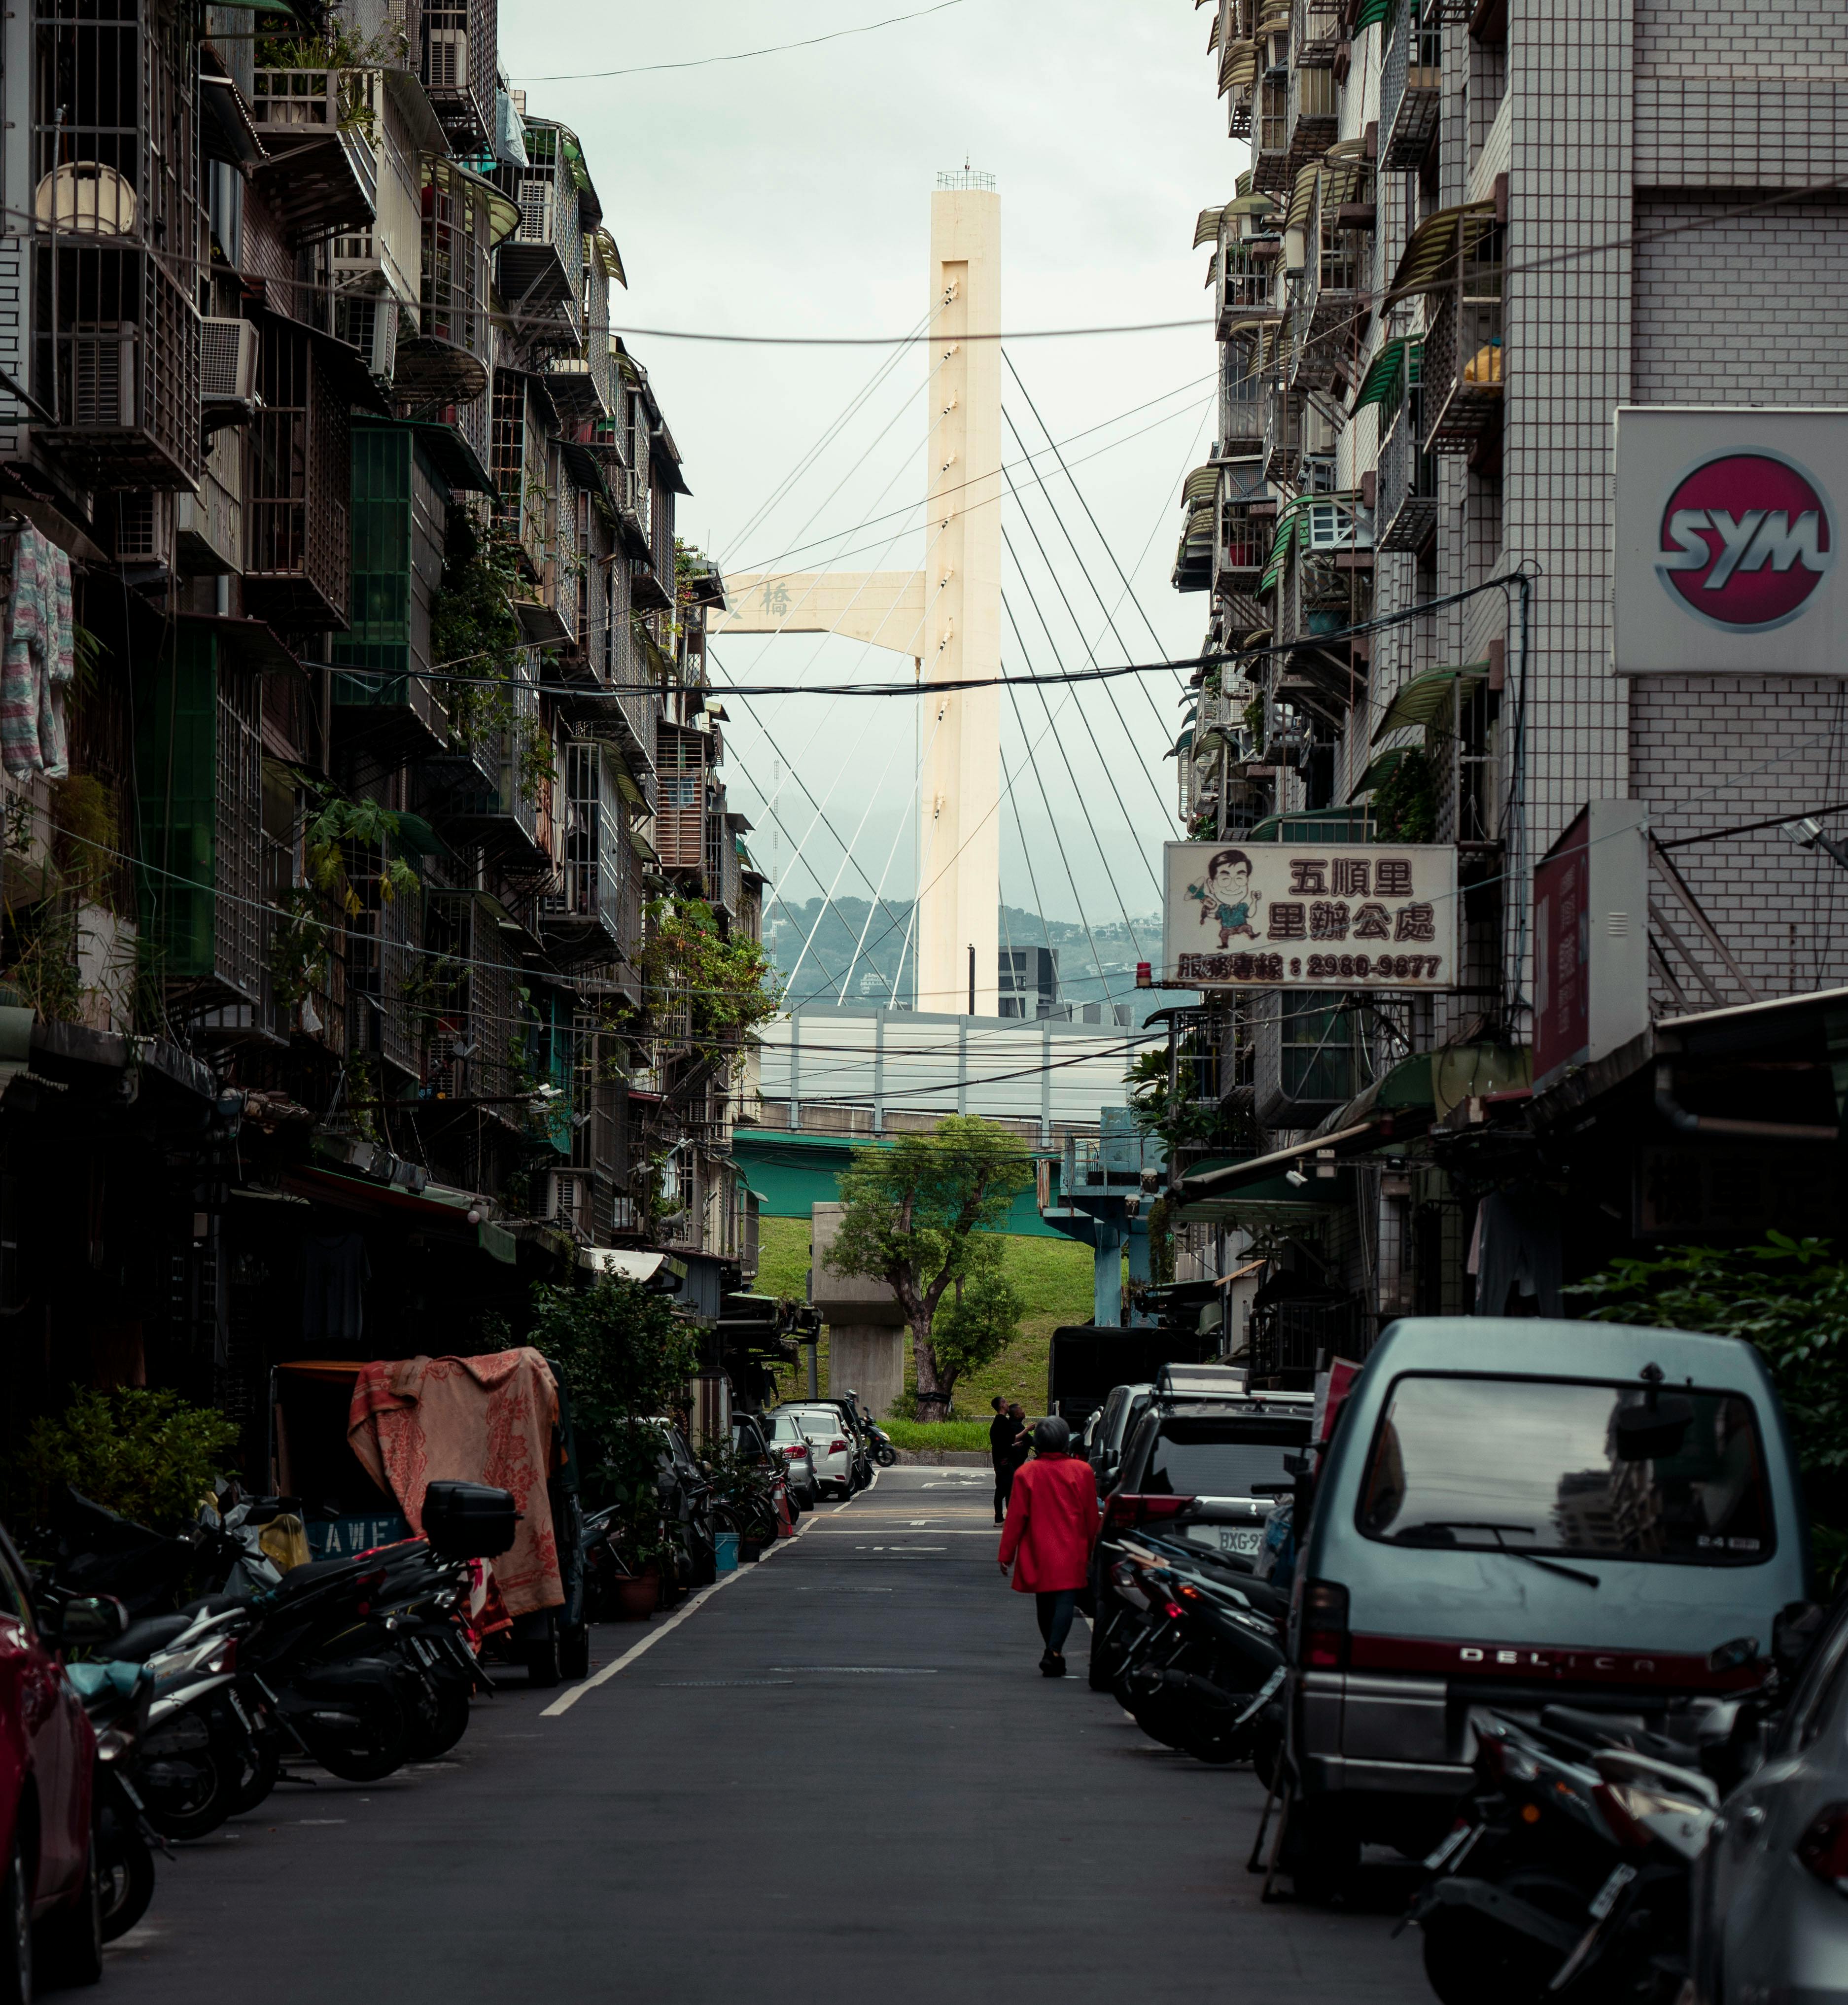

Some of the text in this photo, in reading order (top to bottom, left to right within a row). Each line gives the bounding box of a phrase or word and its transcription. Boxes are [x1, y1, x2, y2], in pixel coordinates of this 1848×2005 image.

[1657, 509, 1831, 589] SYM
[1289, 858, 1413, 897] 五順里
[1267, 901, 1435, 942] 里辦公處
[1648, 1154, 1848, 1226] 機車定
[1220, 1532, 1262, 1549] BXG-9
[1459, 1647, 1656, 1674] DELICA
